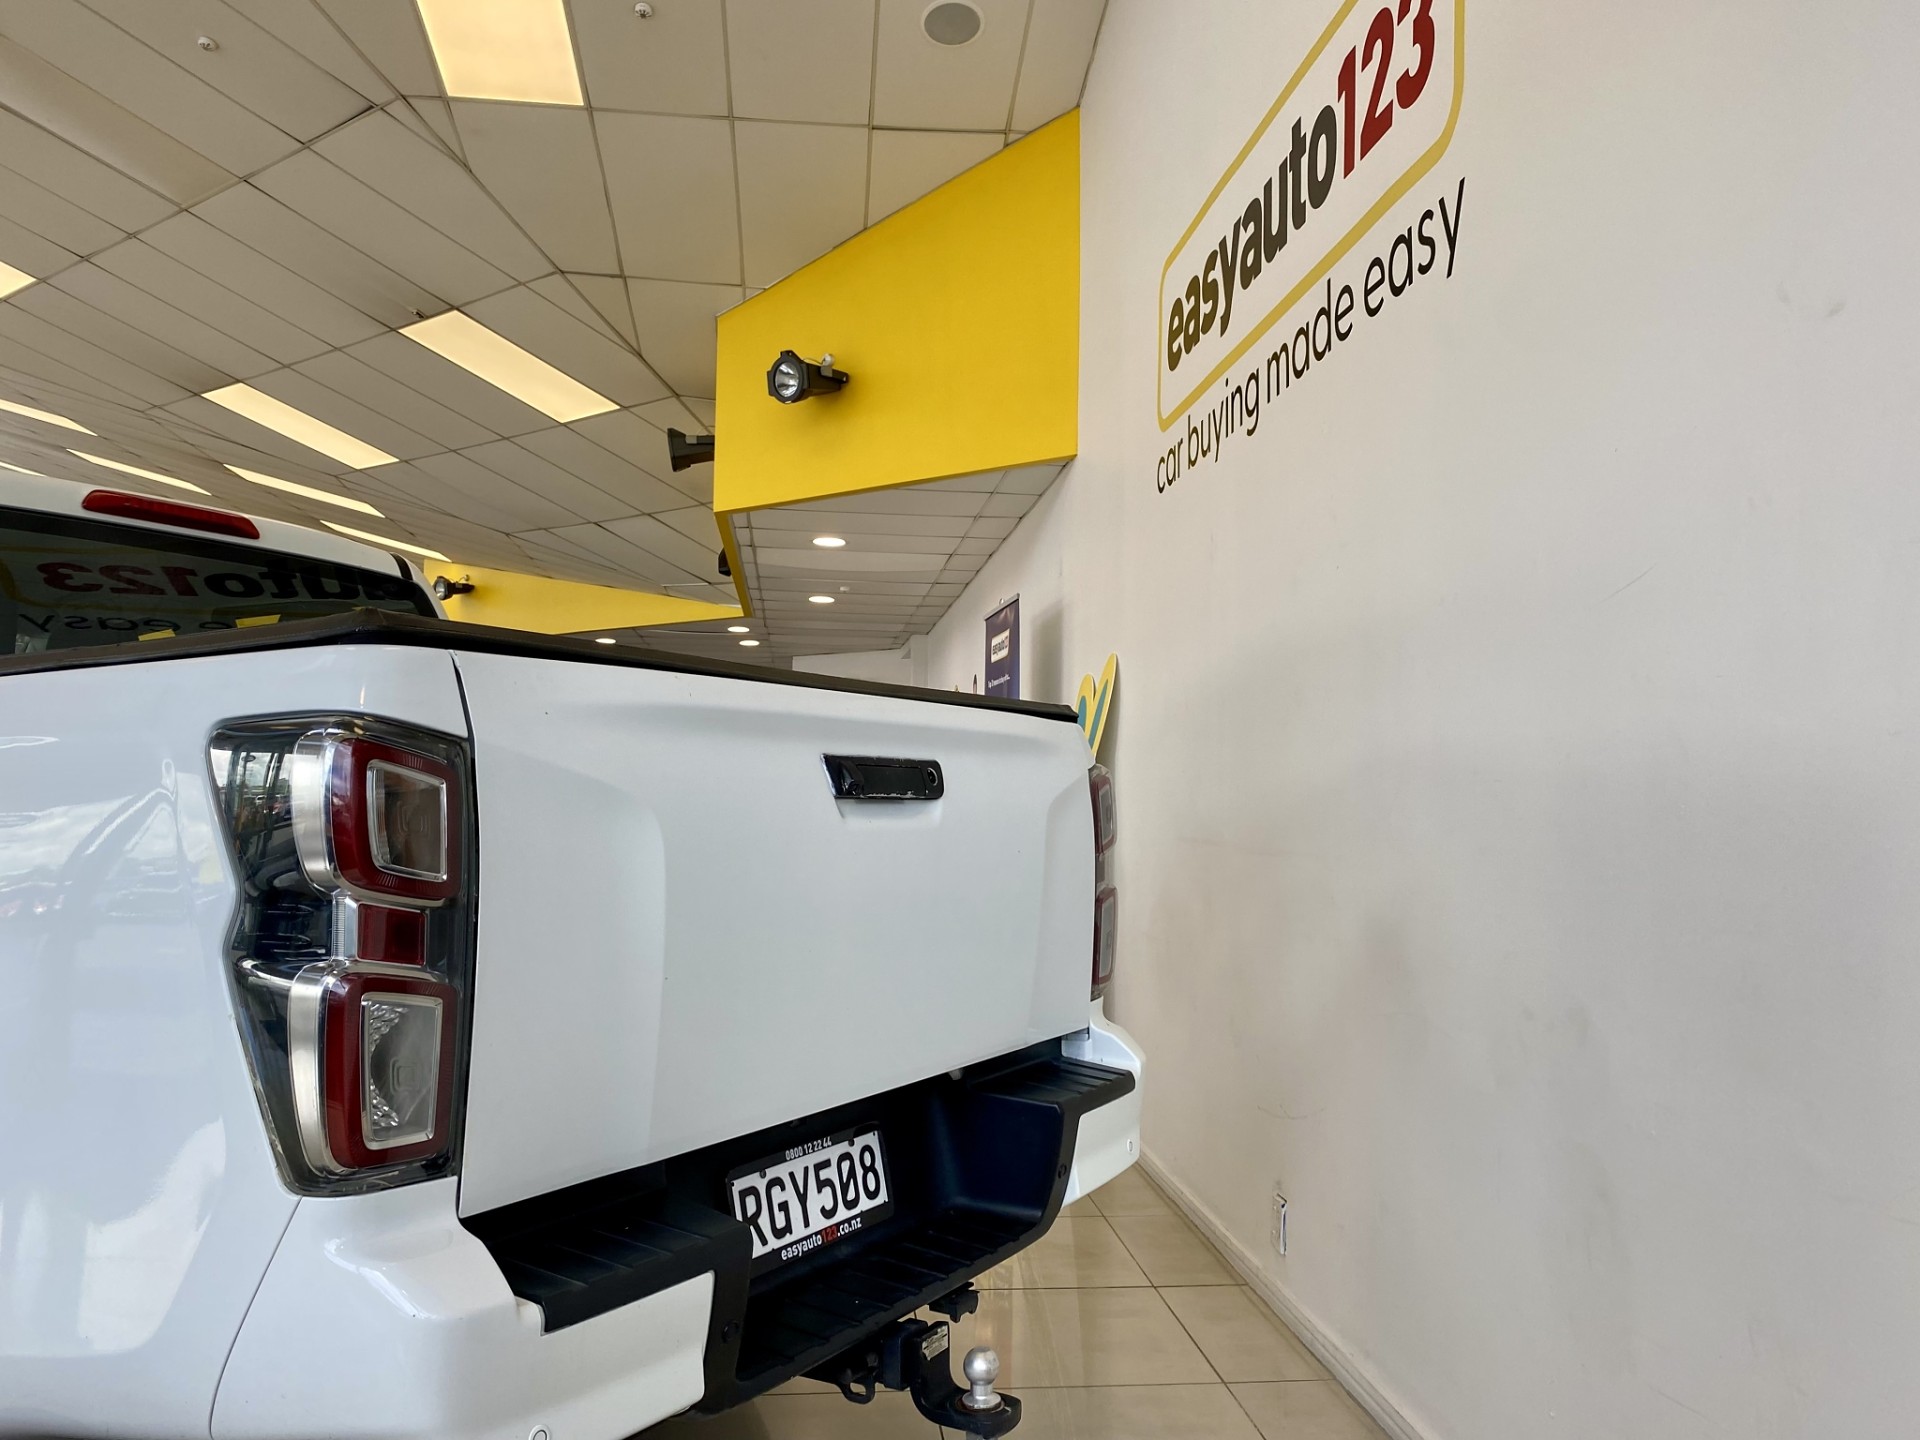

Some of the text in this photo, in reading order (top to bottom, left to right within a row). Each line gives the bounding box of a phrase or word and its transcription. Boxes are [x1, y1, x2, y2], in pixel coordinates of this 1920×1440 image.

[1166, 0, 1436, 372] easyauto123
[1155, 176, 1466, 495] car buying made easy
[738, 1144, 881, 1247] RGY508
[785, 1136, 832, 1161] 0800 12 22 44
[780, 1216, 863, 1261] easyauto123.co.nz
